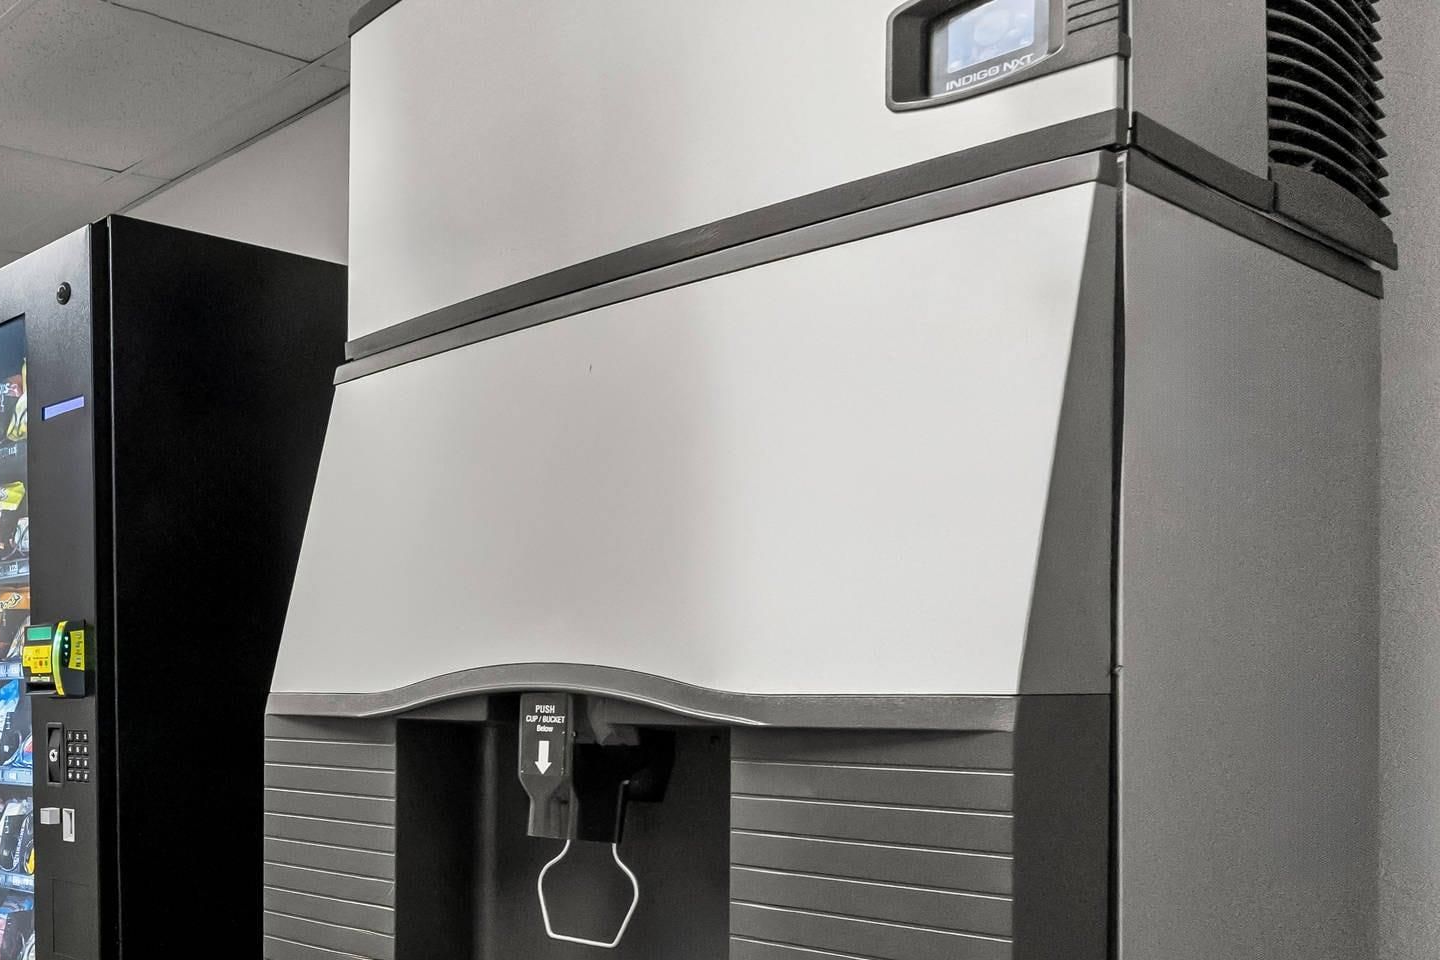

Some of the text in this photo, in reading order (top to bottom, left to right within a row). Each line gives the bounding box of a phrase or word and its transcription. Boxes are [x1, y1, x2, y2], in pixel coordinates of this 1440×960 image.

[945, 53, 1035, 91] INDIGO NXT
[535, 704, 555, 714] PUSH
[542, 715, 565, 723] BUCKET
[536, 724, 553, 732] Below
